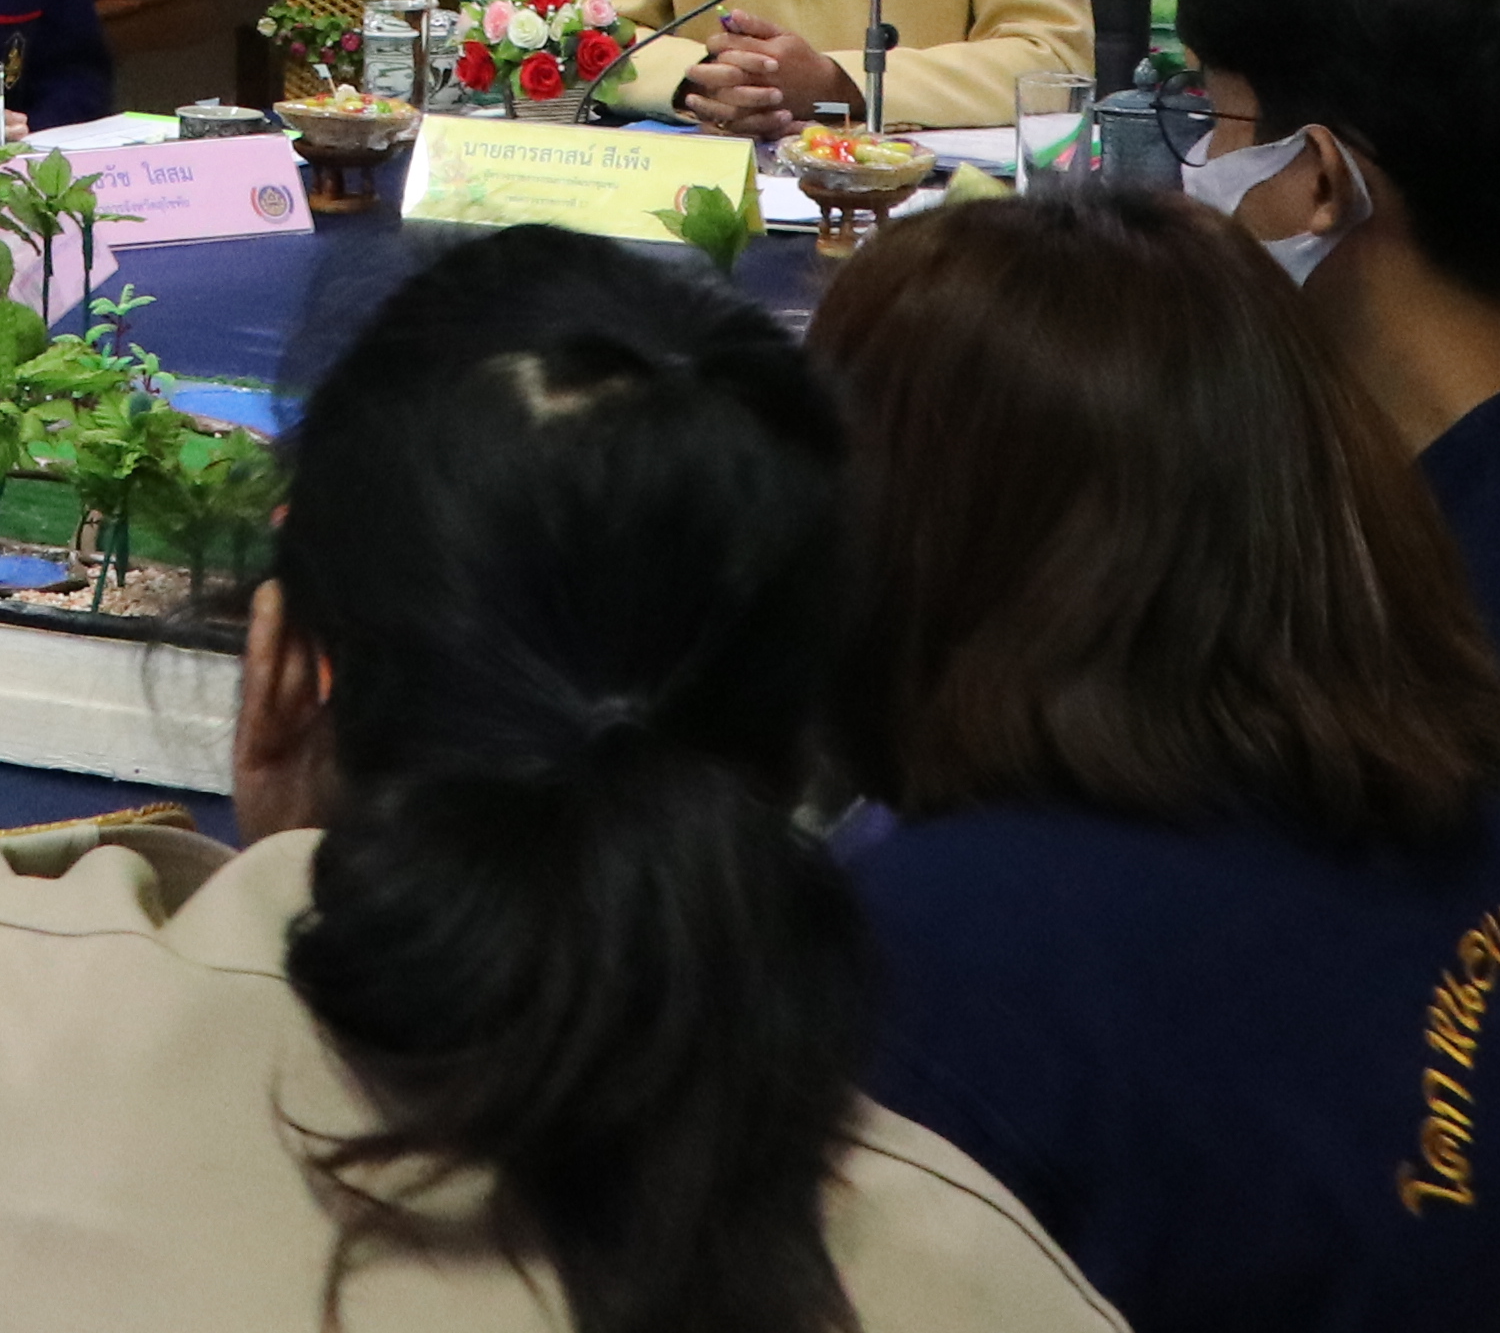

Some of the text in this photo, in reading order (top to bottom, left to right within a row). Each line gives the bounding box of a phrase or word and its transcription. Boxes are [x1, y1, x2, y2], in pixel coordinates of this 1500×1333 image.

[463, 139, 652, 172] นายสารสาสน์ สีเพ็ง
